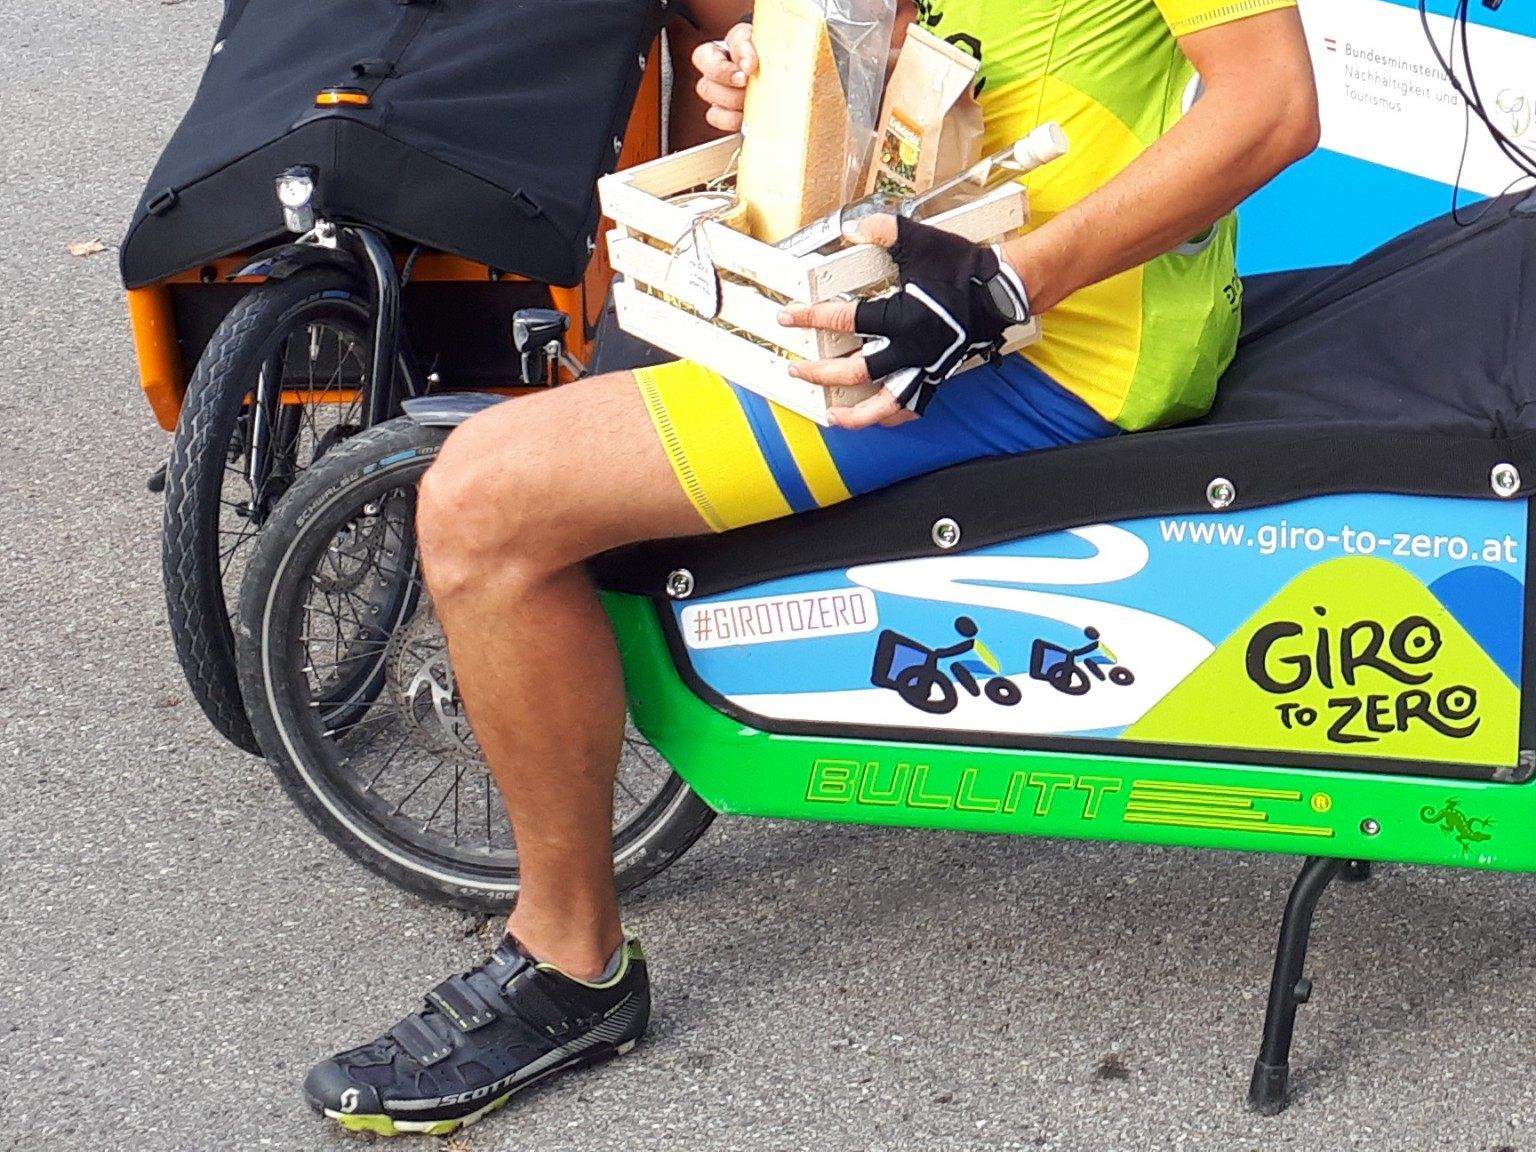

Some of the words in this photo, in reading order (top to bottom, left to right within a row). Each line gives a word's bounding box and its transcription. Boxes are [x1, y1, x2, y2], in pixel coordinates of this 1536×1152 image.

[1345, 42, 1452, 82] Bundesministeriu
[1344, 64, 1431, 98] Nachhaltigkeit
[1435, 88, 1458, 106] und
[1344, 84, 1402, 112] Tourismus
[1160, 519, 1518, 564] www.giro-to-zero.at
[694, 593, 867, 641] #GIROTOZERO
[1326, 684, 1481, 744] ZERO
[807, 758, 1123, 819] BULLITT
[439, 1073, 520, 1108] SCOTT
